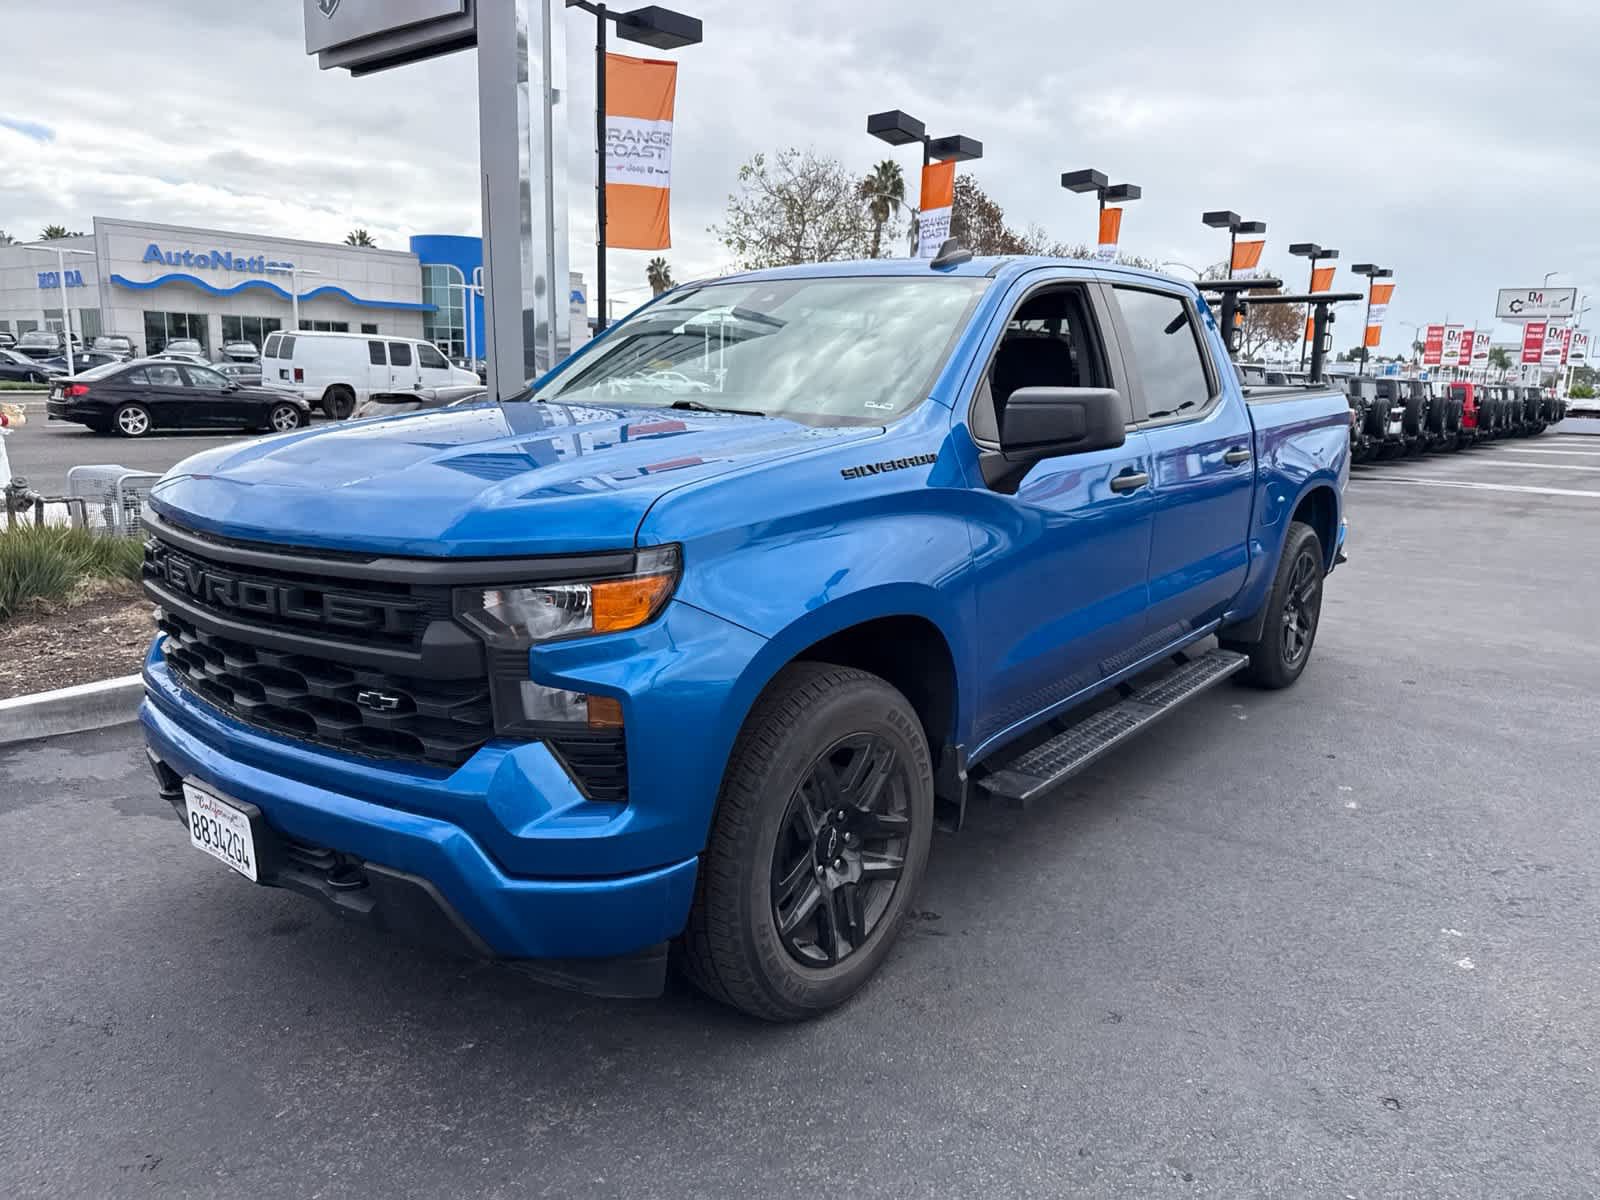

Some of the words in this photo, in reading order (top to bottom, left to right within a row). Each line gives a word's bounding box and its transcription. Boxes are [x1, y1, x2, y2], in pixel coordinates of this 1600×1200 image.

[607, 128, 671, 146] RANGE
[841, 453, 938, 480] SILVERADO
[192, 811, 250, 870] 88342G4
